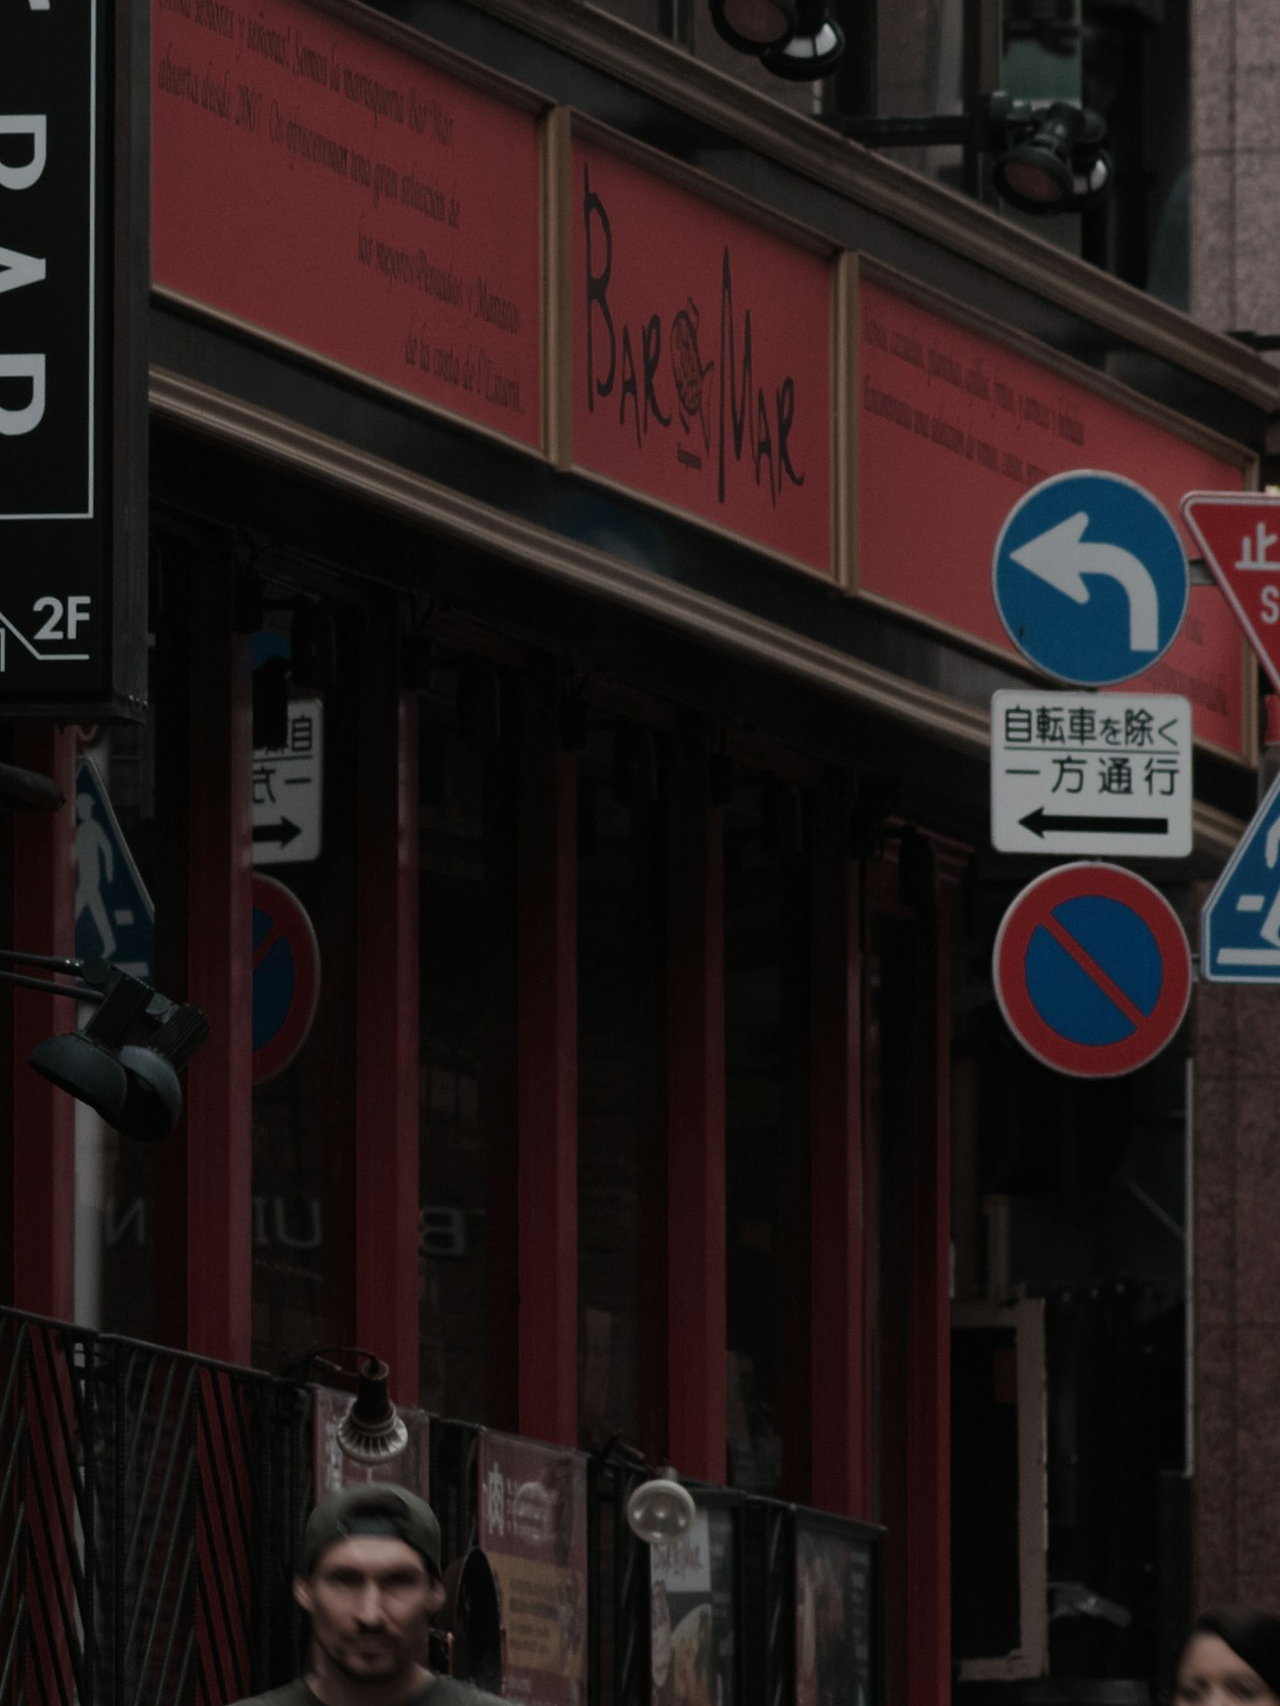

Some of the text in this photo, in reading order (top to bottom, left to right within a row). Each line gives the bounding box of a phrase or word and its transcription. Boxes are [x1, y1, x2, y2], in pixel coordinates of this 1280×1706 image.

[32, 595, 90, 642] 2F
[1004, 704, 1180, 747] 自転車を除く
[1004, 755, 1181, 797] 一方通行
